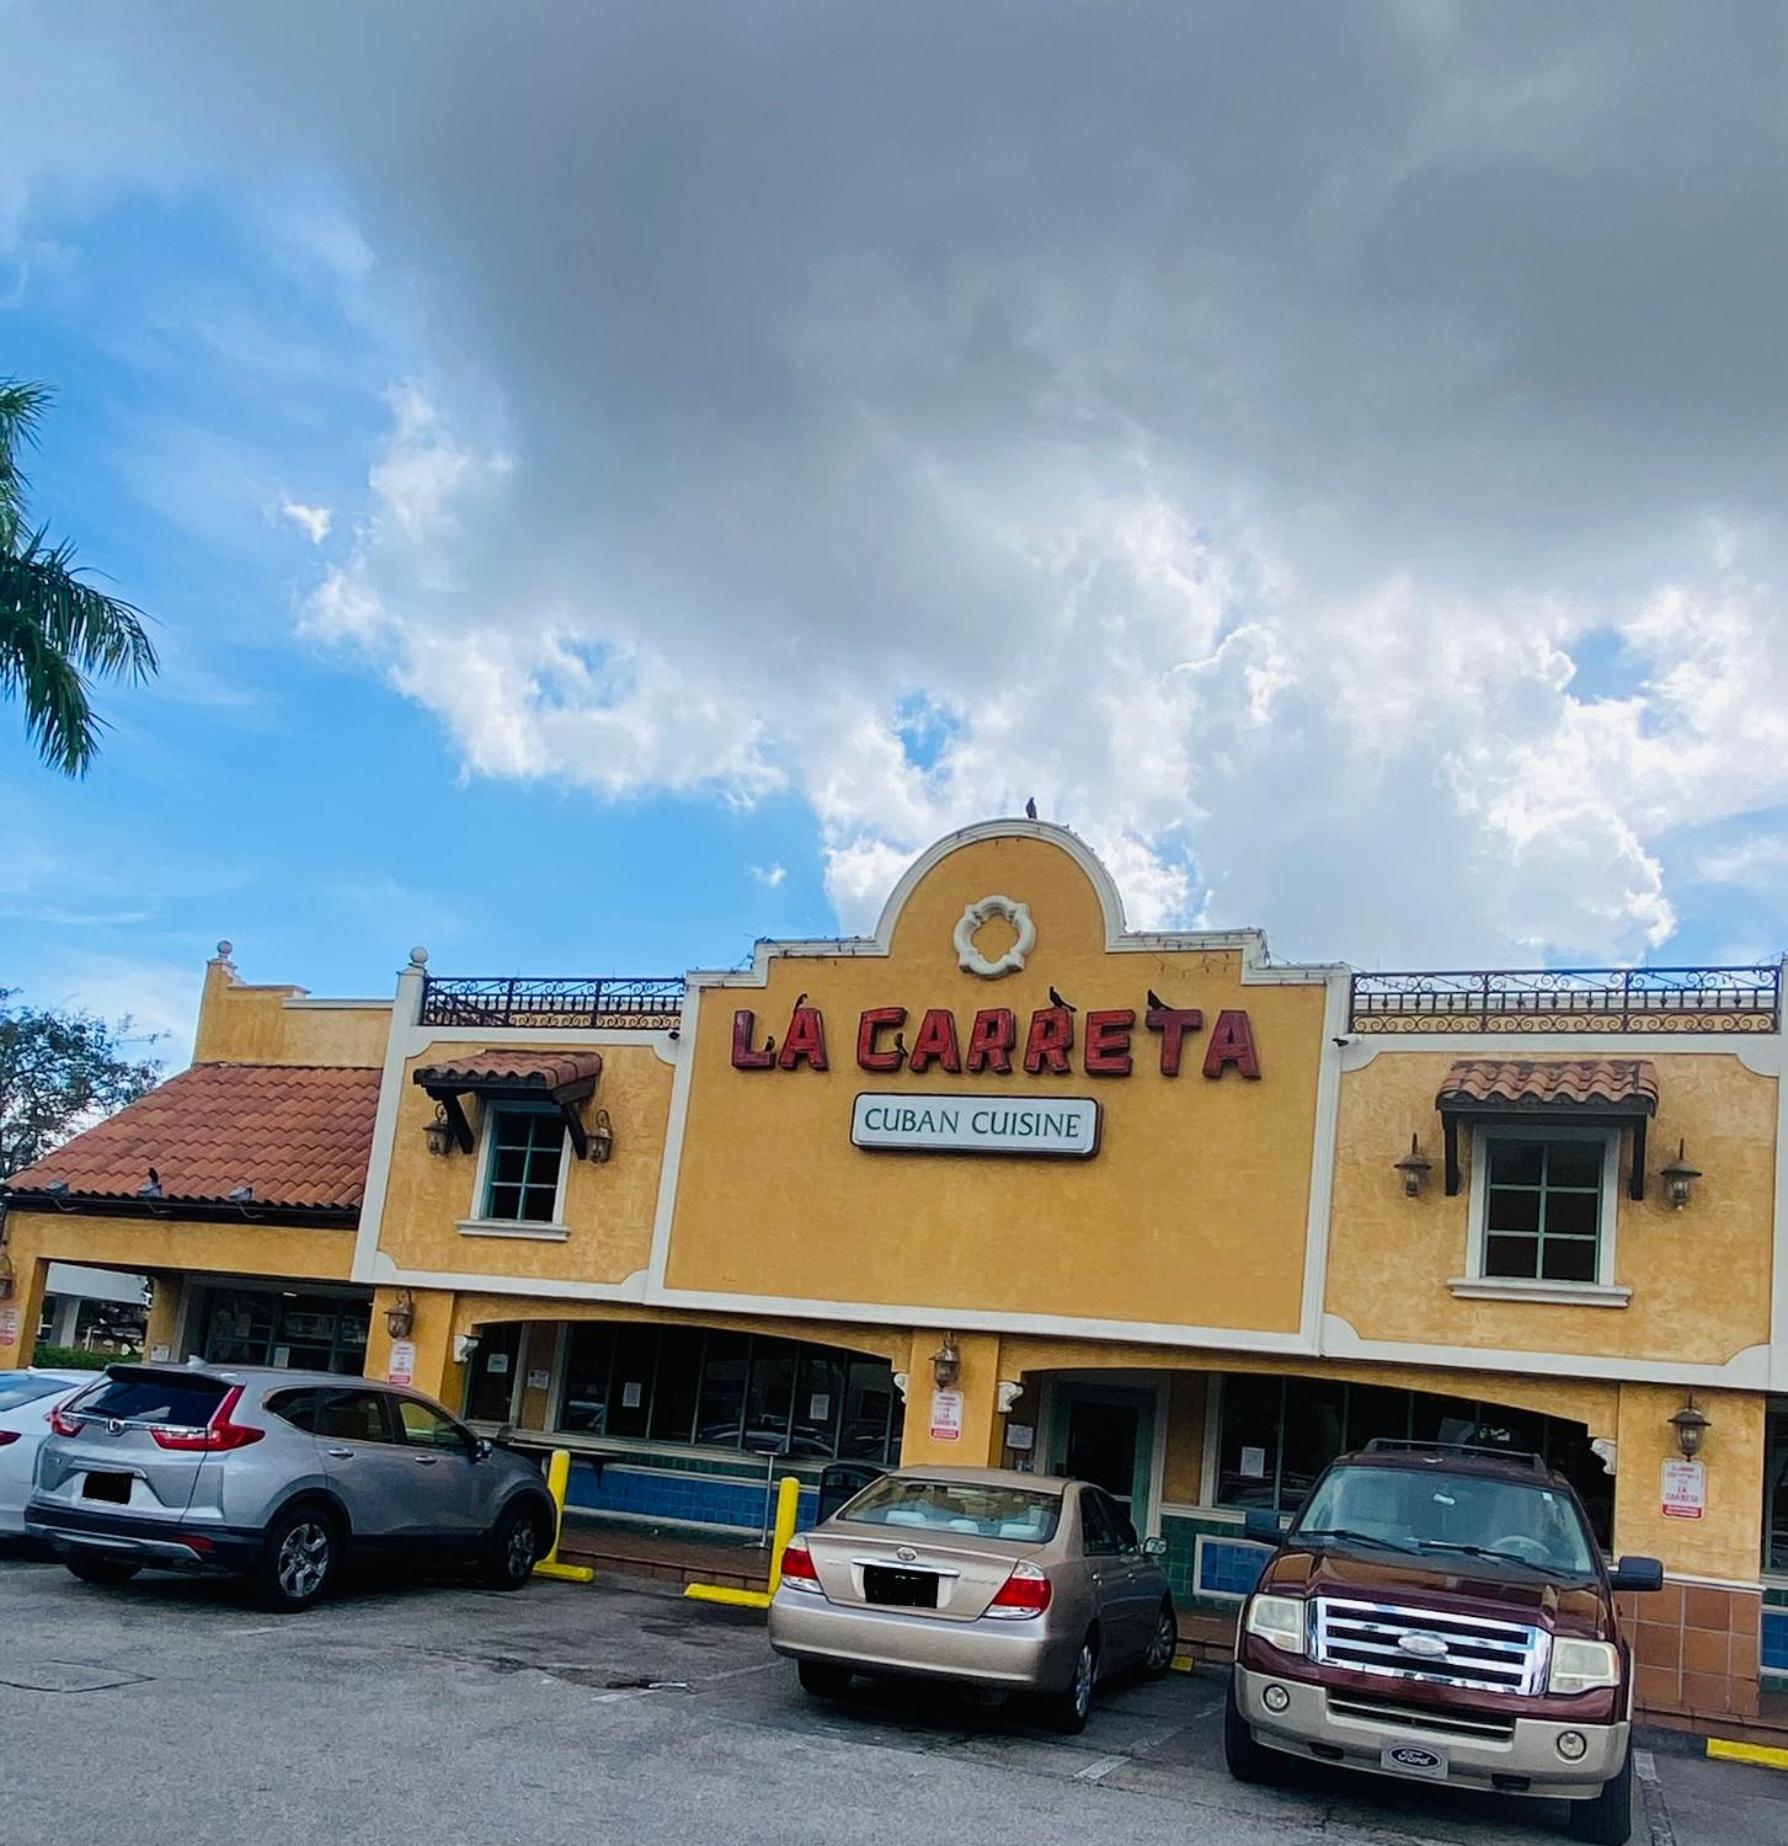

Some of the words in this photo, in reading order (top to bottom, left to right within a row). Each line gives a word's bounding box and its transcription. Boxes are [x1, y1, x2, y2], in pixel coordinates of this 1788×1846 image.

[732, 1007, 828, 1070] LA
[857, 1007, 1261, 1078] CARRETA
[864, 1107, 960, 1134] CUBAN
[971, 1111, 1081, 1138] CUISINE
[1397, 1749, 1431, 1765] Ford
